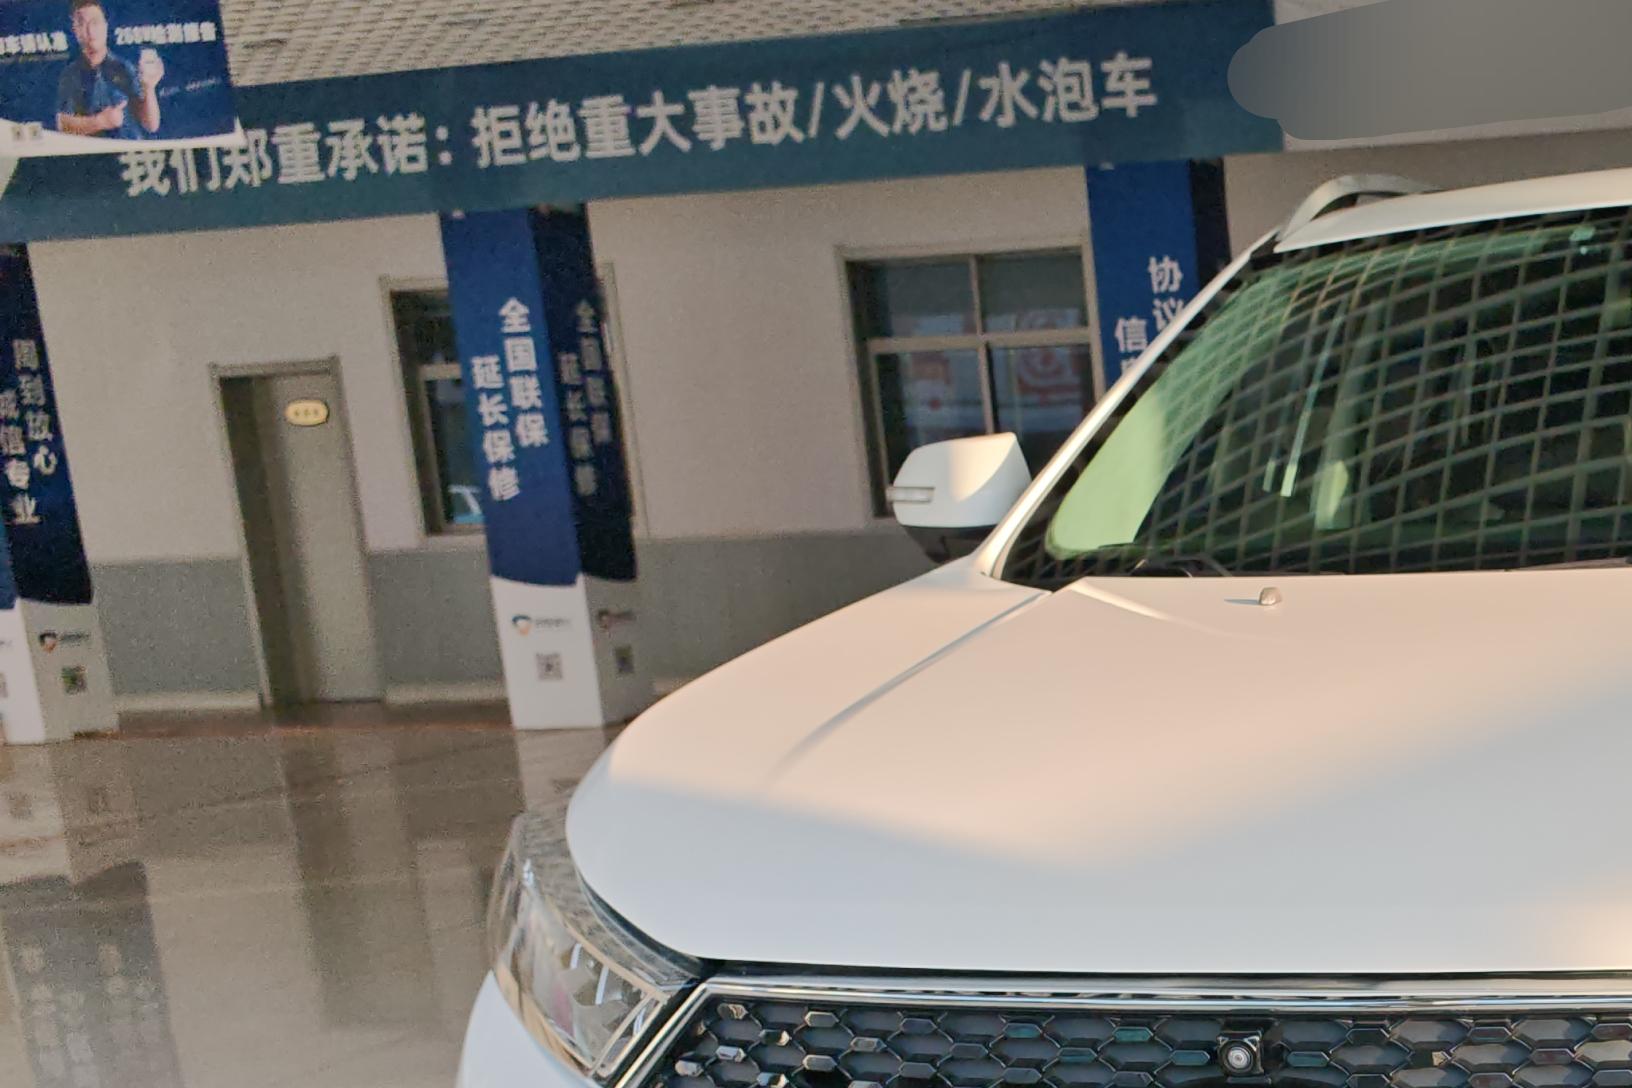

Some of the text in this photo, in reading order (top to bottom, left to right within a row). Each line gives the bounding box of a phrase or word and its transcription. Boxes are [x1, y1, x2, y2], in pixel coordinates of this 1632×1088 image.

[471, 353, 521, 502] 延长保修
[498, 296, 550, 448] 全国联保
